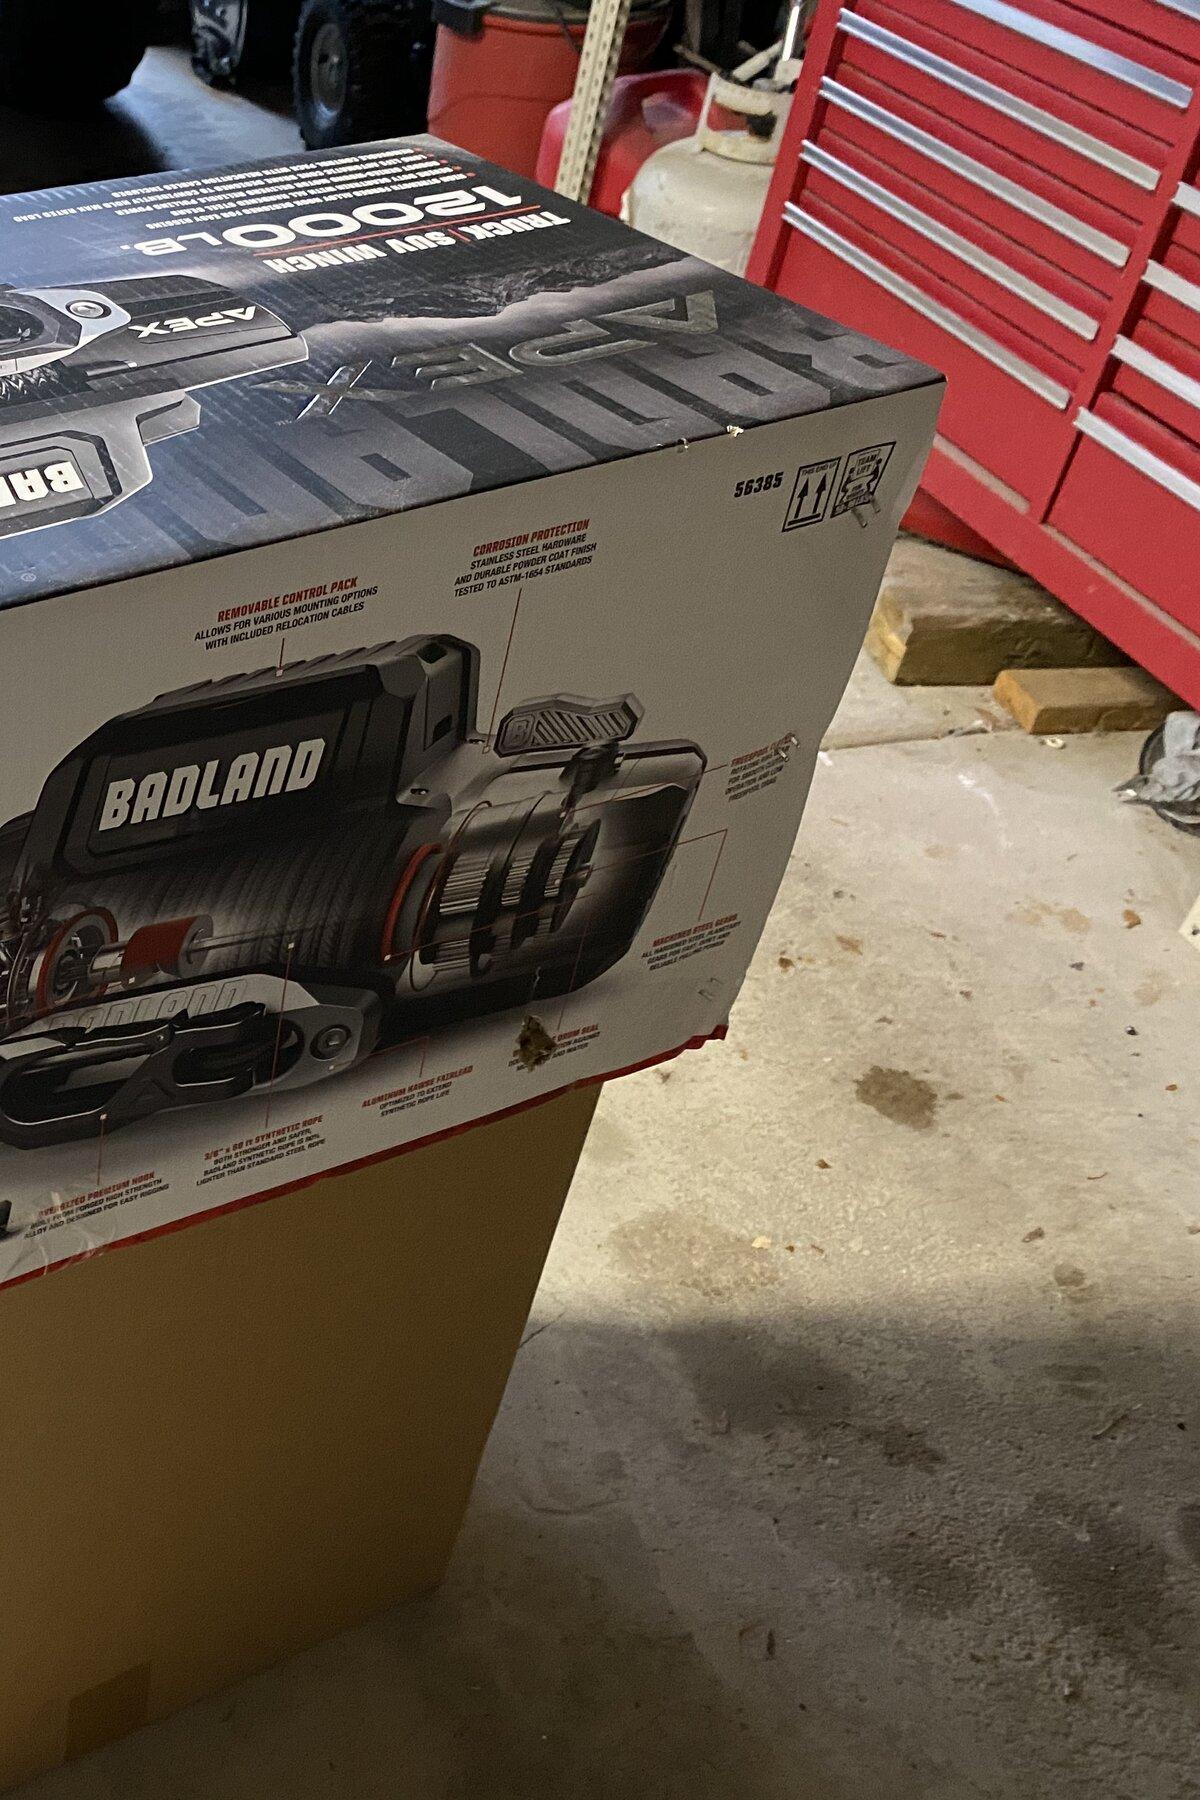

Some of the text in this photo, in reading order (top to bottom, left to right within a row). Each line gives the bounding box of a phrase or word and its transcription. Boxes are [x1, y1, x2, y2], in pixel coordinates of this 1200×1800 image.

[9, 212, 43, 222] LOAD
[259, 210, 575, 274] TRUCK SUV WINCH
[135, 304, 262, 340] APEX
[244, 289, 719, 422] APEX
[732, 470, 785, 499] 56385
[529, 517, 590, 544] PROTECTION
[514, 544, 540, 559] STEEL
[547, 548, 570, 563] COAT
[281, 575, 358, 606] CONTROL PACK
[485, 579, 497, 590] TO
[193, 585, 378, 642] ALLOWS FOR VARIOUS MOUNTING OPTIONS
[204, 600, 365, 651] WITH INCLUDED RELOCATION CABLES
[98, 736, 325, 832] BADLAND
[246, 1151, 284, 1170] STANDARD
[124, 1177, 162, 1196] STRENGTH
[139, 1182, 169, 1199] RIGGING
